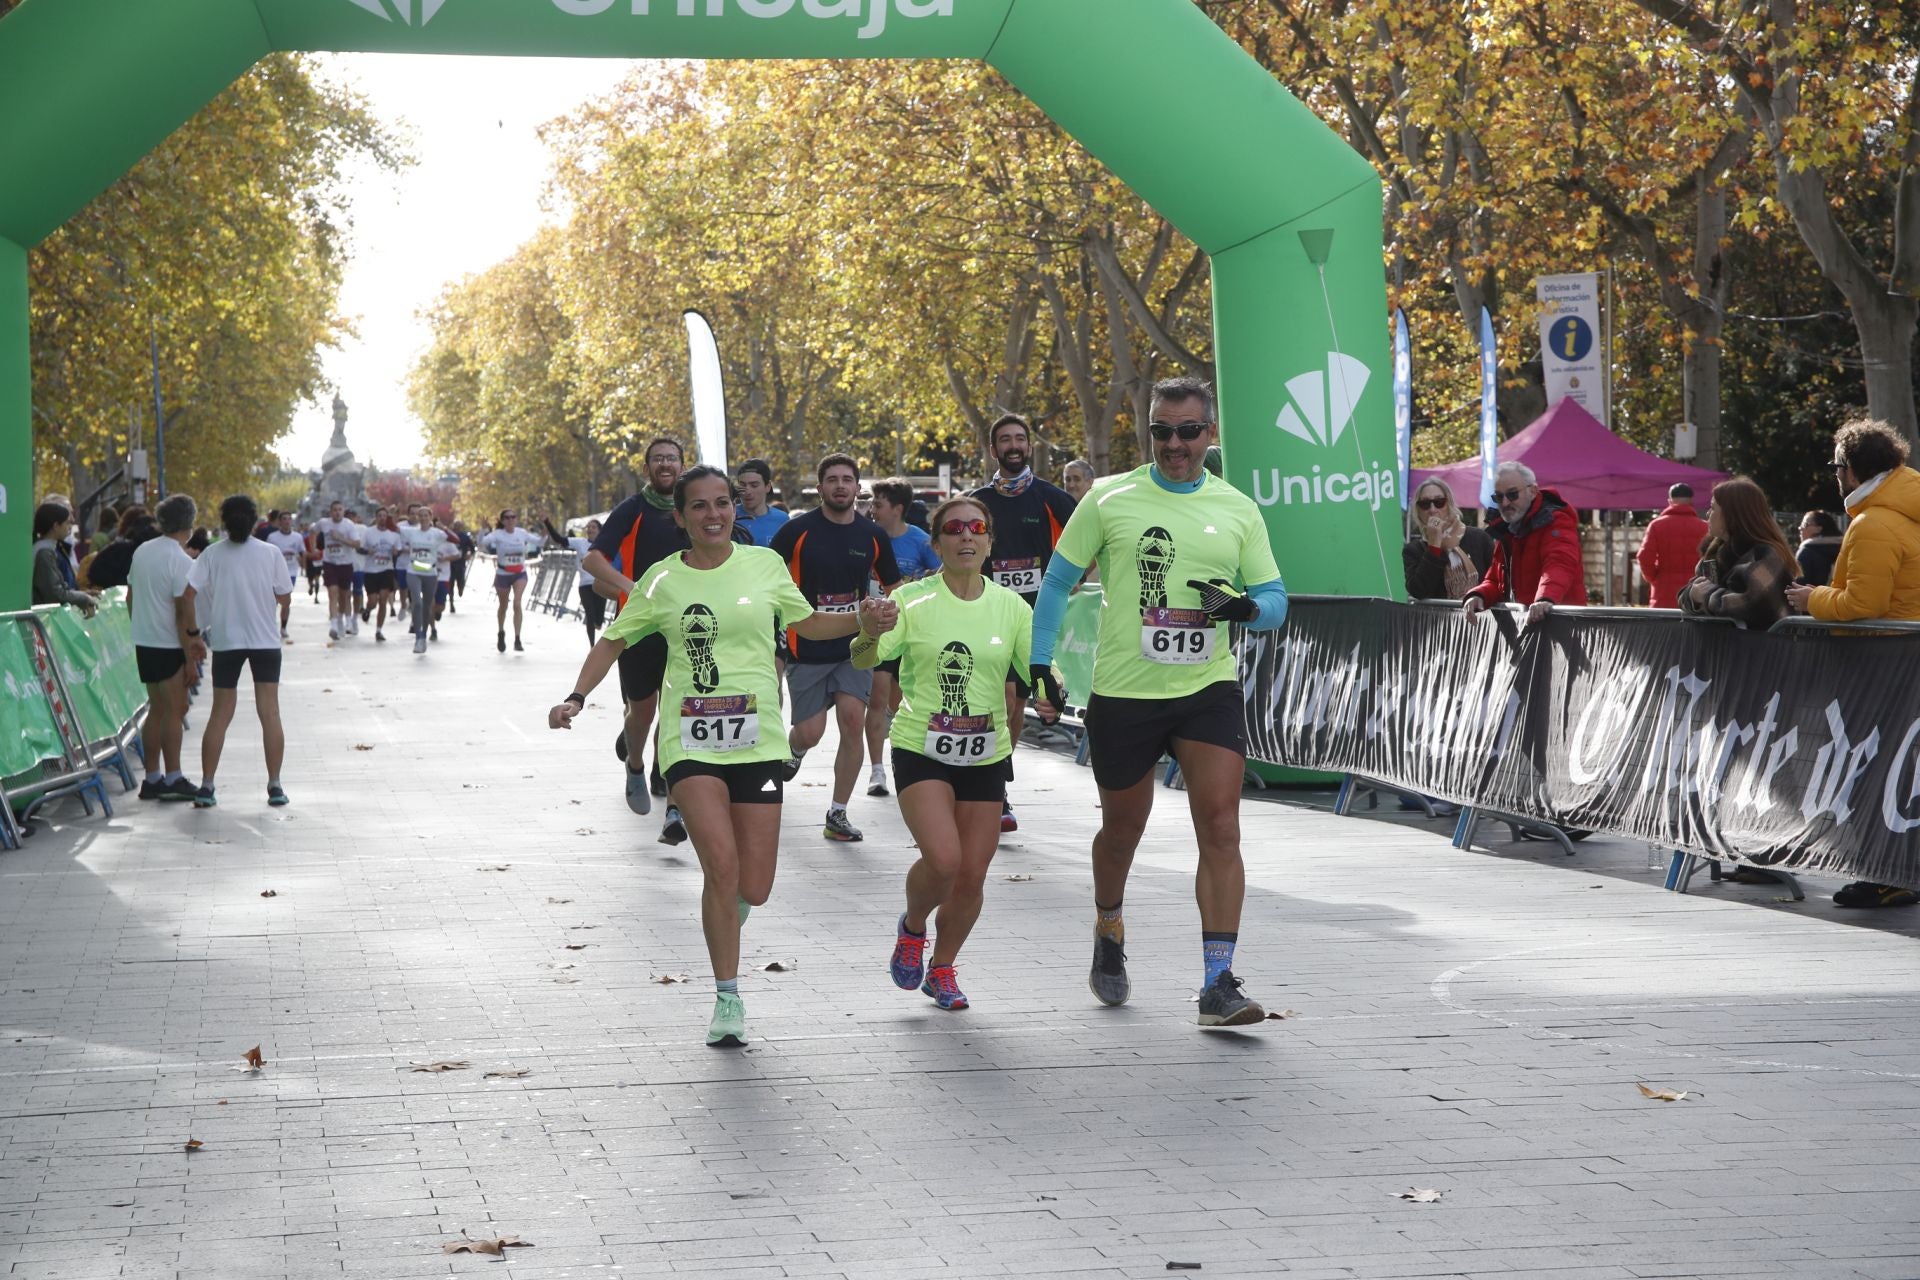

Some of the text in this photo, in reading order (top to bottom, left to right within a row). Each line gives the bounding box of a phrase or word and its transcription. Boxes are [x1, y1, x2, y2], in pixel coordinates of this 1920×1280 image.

[1571, 282, 1581, 290] de
[1252, 461, 1395, 511] Unicaja
[1001, 571, 1035, 587] 562
[1152, 630, 1205, 653] 619
[691, 717, 745, 741] 617
[935, 735, 986, 757] 618
[1800, 698, 1880, 826] de
